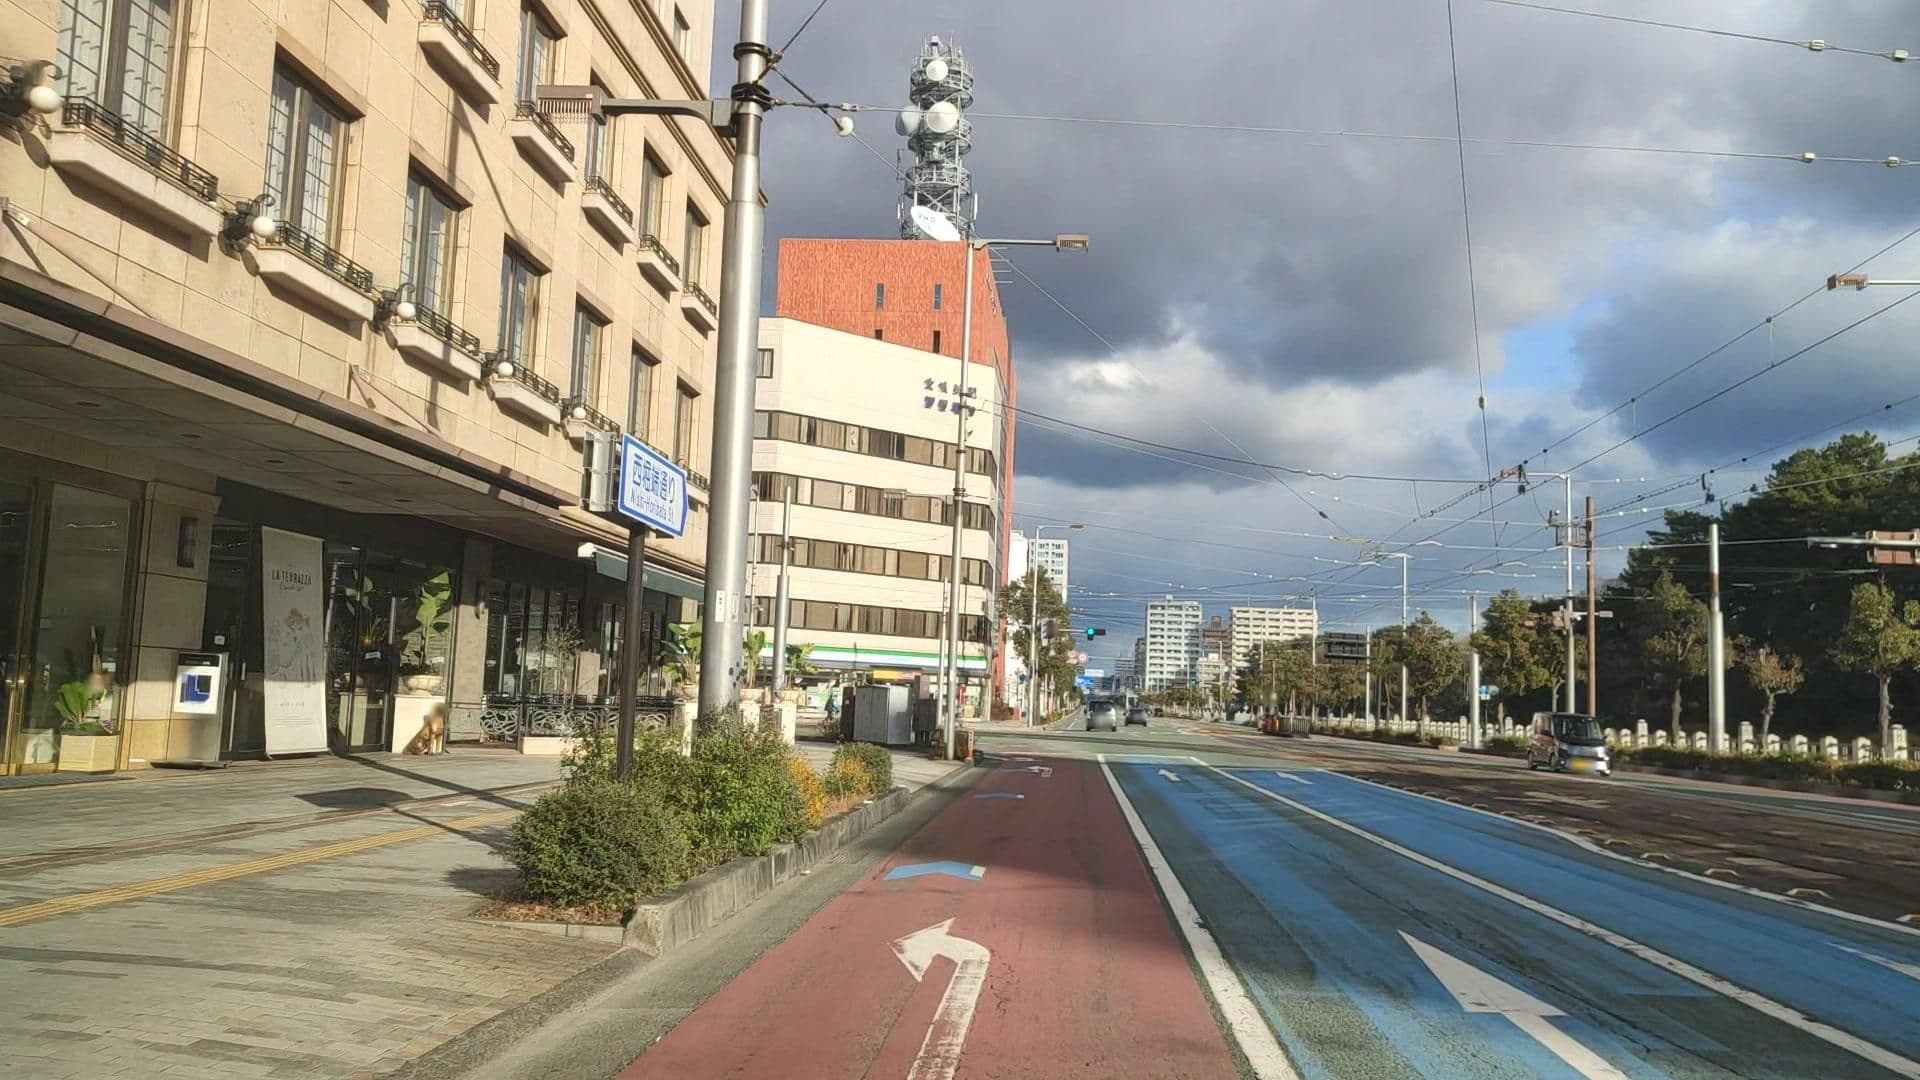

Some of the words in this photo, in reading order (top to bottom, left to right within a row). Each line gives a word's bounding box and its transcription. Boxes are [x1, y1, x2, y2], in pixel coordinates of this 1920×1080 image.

[633, 452, 675, 504] 西堀端通り
[272, 568, 280, 580] LA
[282, 570, 312, 585] TERRAZZA
